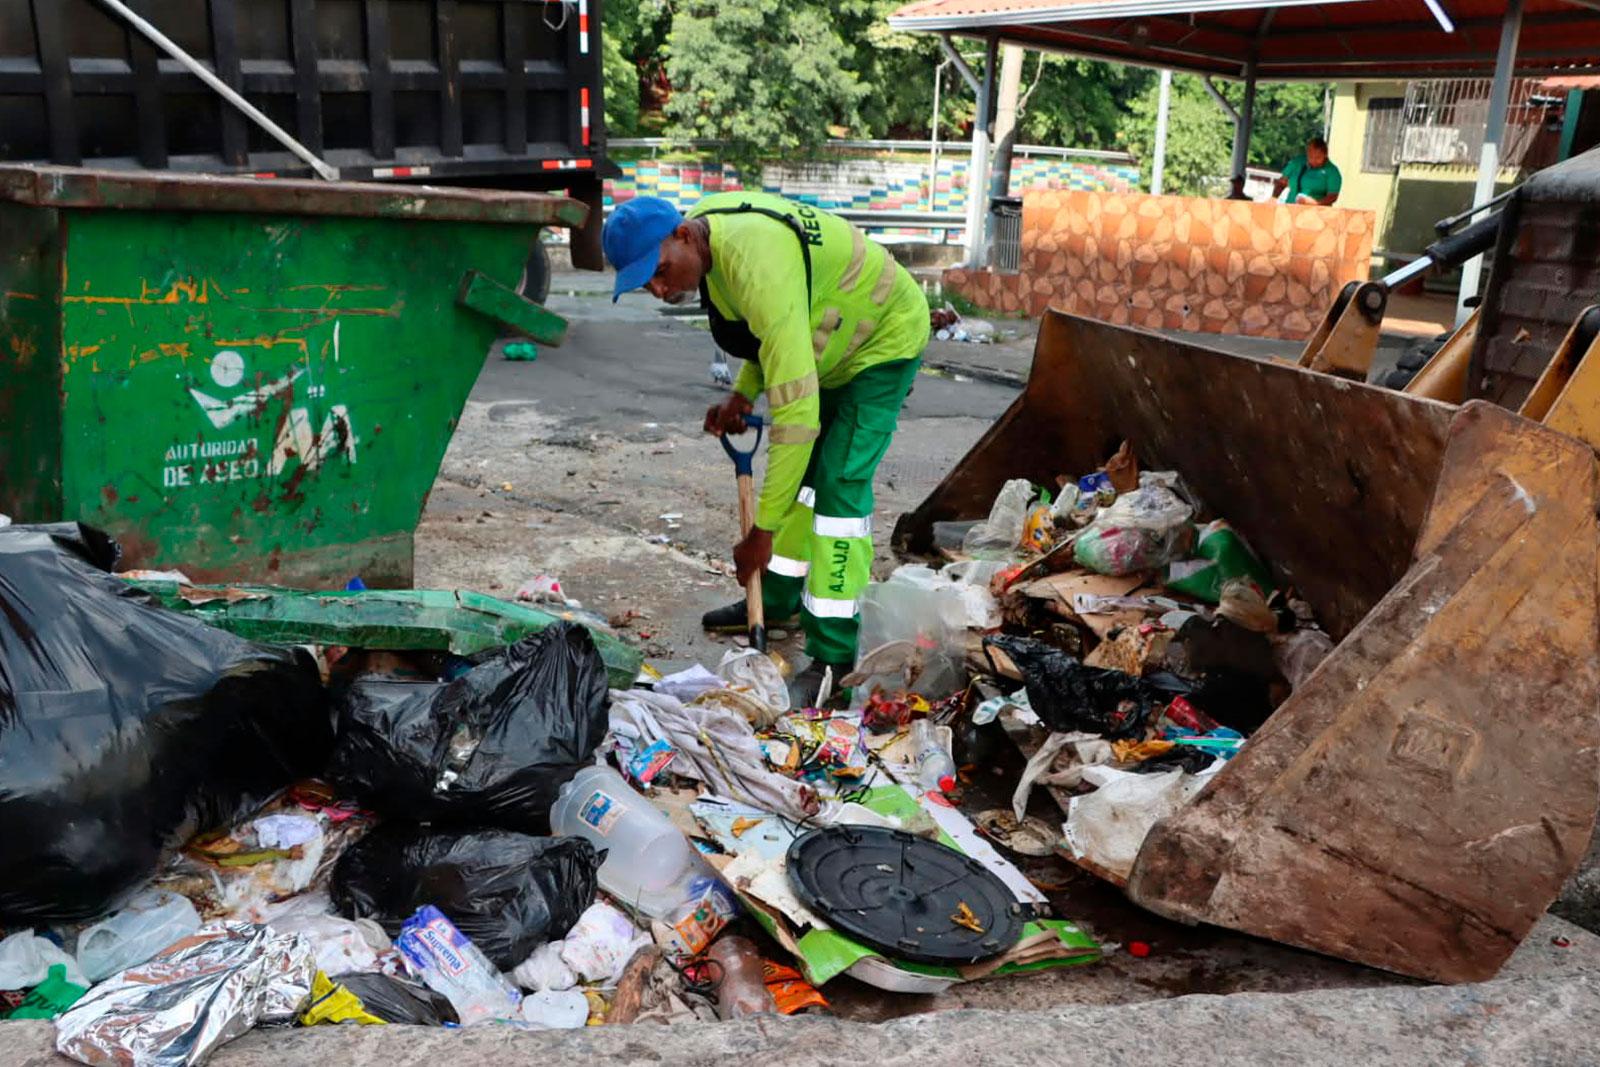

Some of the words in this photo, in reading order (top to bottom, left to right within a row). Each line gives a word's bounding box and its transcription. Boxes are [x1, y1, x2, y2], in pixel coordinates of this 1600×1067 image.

[163, 465, 193, 487] DE
[200, 459, 259, 484] ASEO
[423, 930, 461, 970] Suprema
